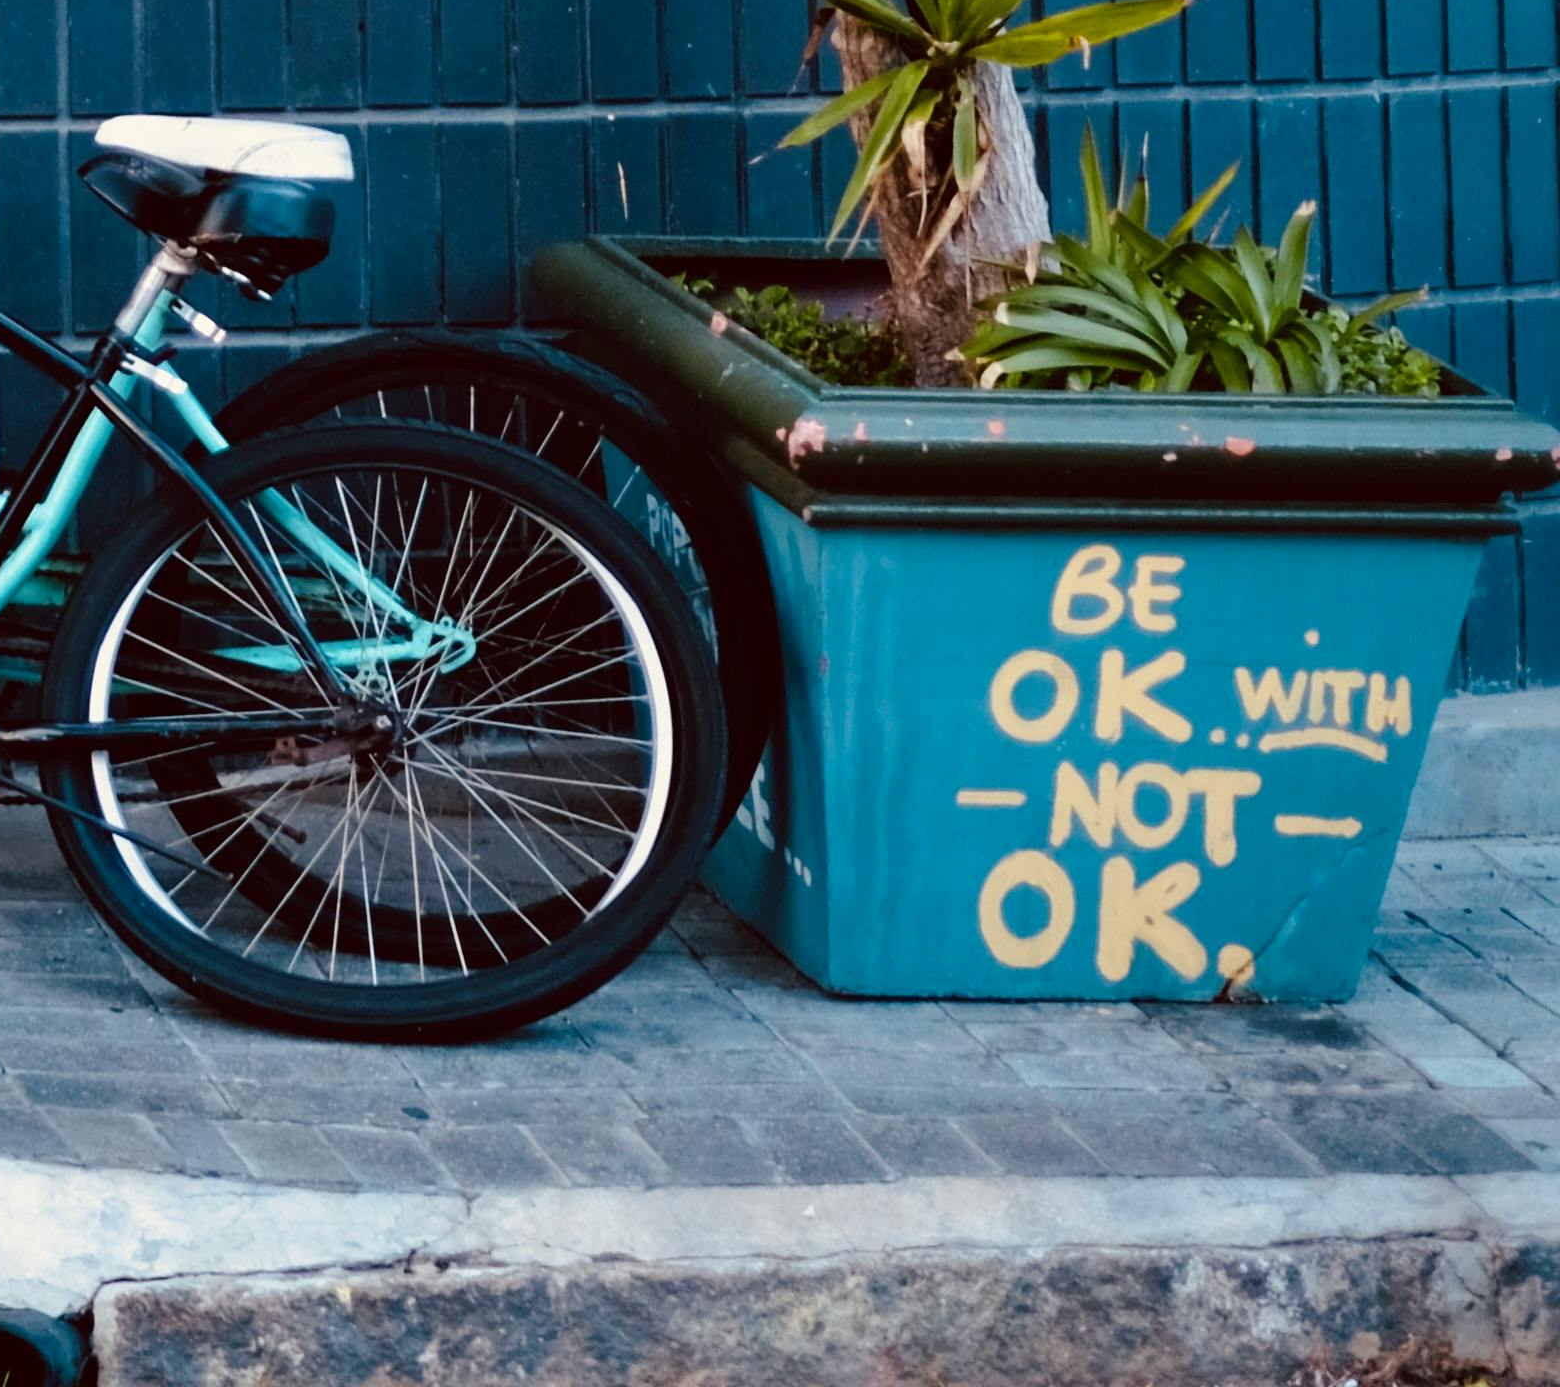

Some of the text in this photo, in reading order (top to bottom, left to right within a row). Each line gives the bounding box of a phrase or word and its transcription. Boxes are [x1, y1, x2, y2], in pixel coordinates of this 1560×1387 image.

[1052, 543, 1187, 638] BE
[1234, 665, 1414, 738] WITH
[1050, 760, 1263, 868] NOT
